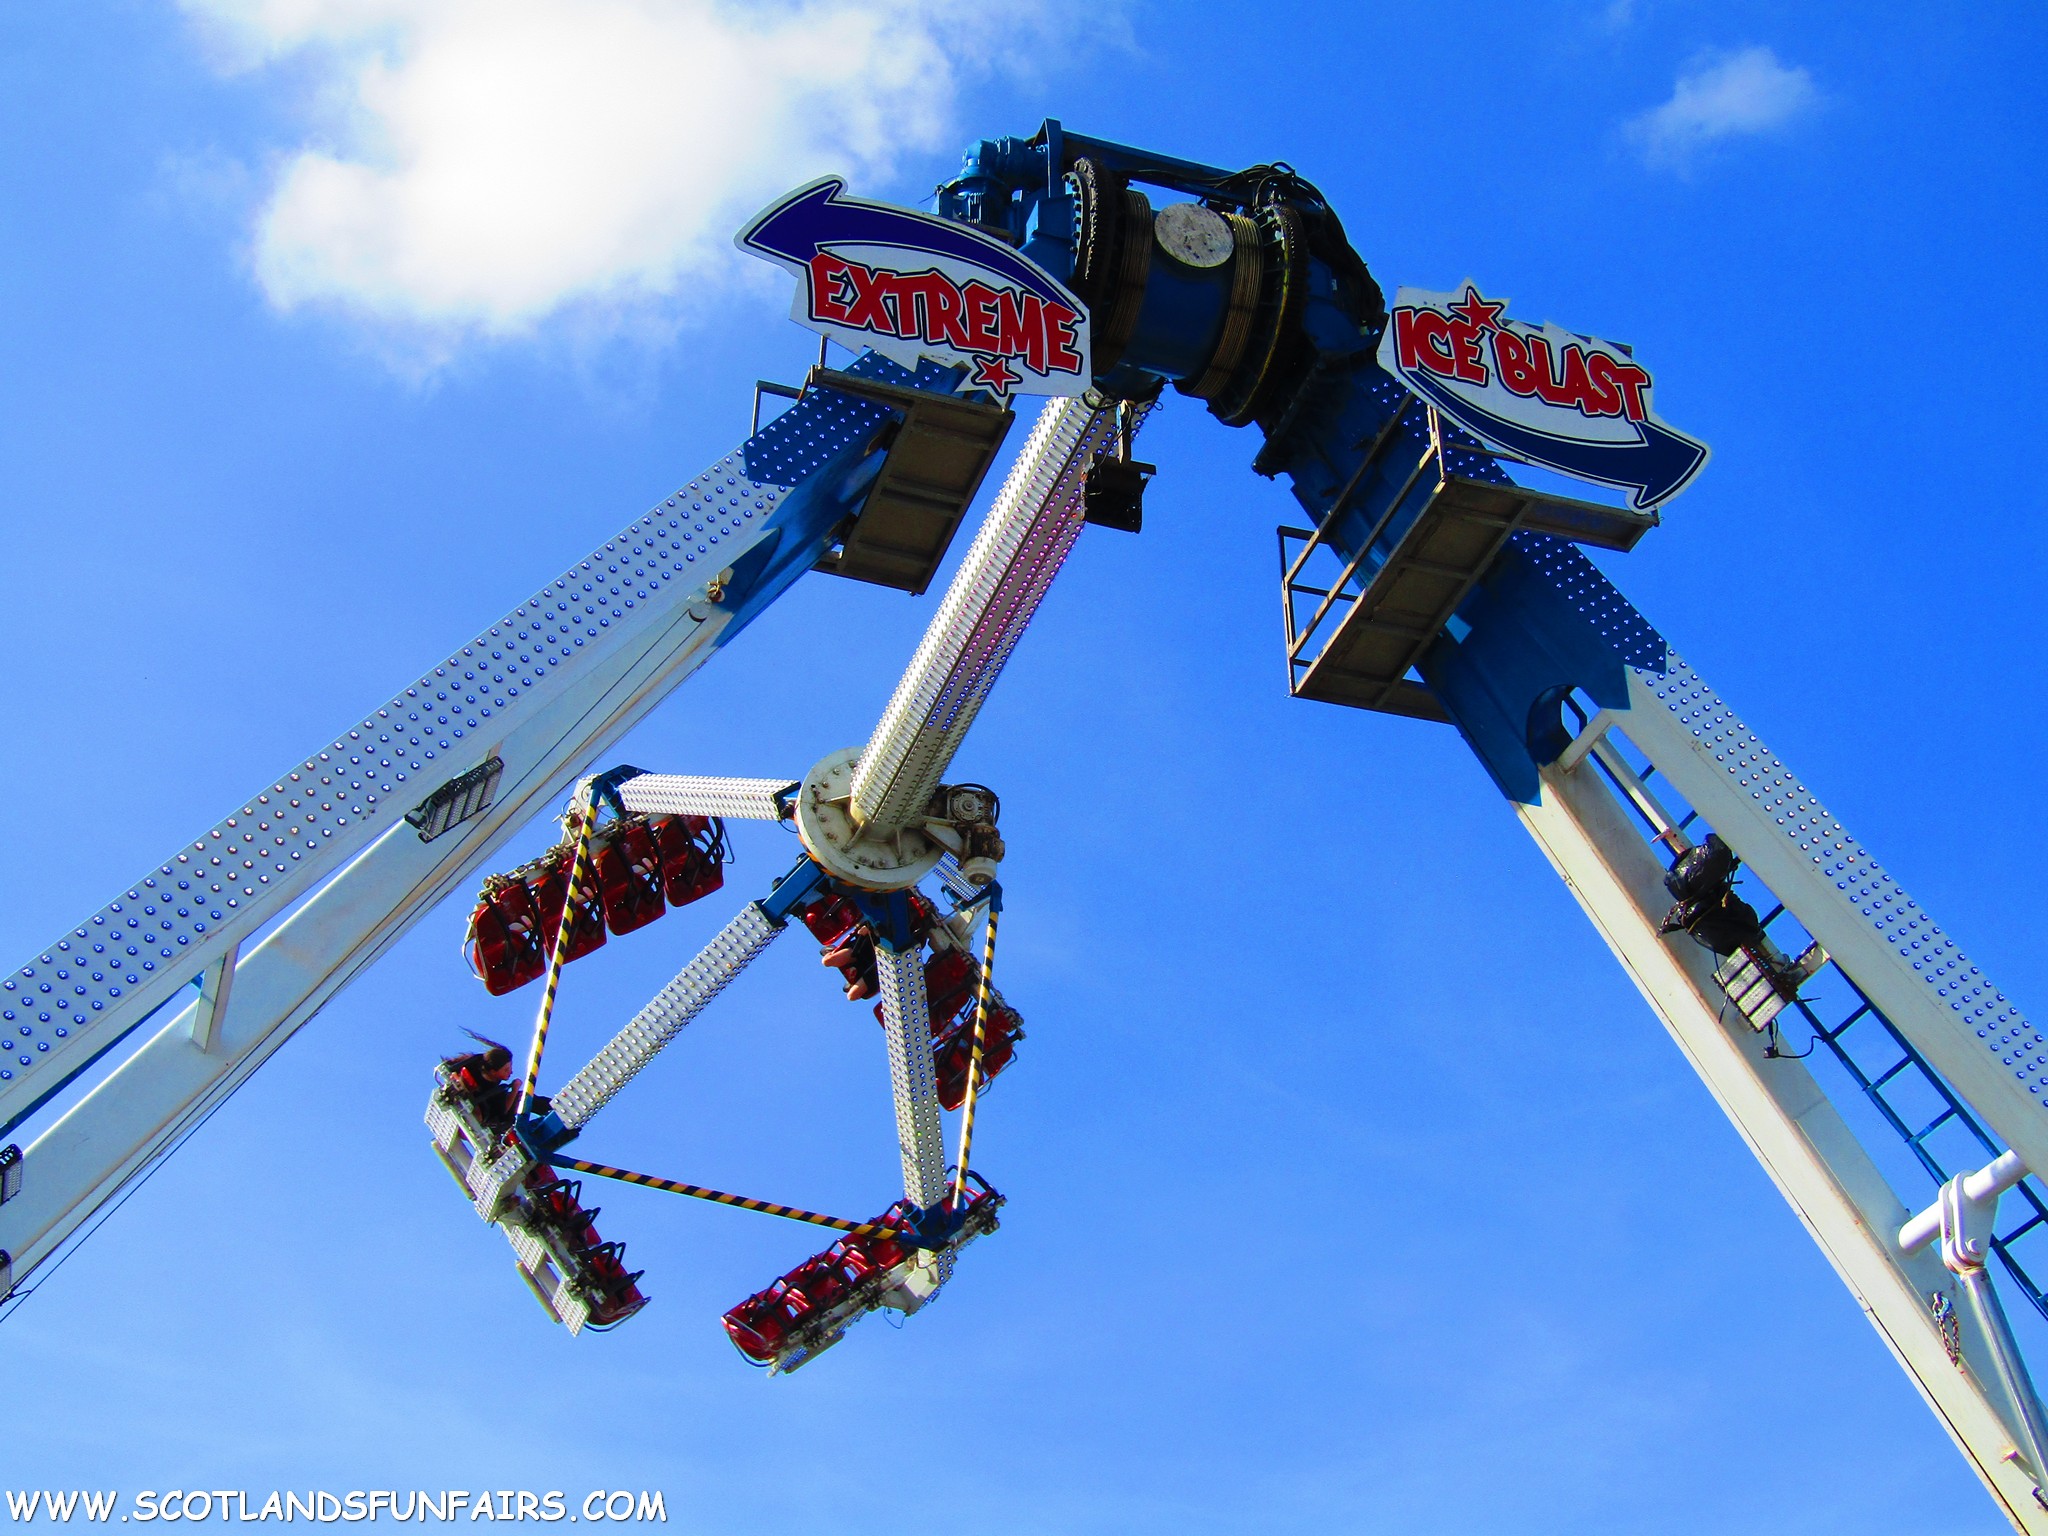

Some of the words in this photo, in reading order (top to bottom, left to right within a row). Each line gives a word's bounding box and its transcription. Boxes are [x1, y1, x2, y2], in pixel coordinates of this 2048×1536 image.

[808, 251, 1084, 373] EXTREME
[1395, 308, 1487, 386] ICE
[1491, 328, 1650, 422] BLAST
